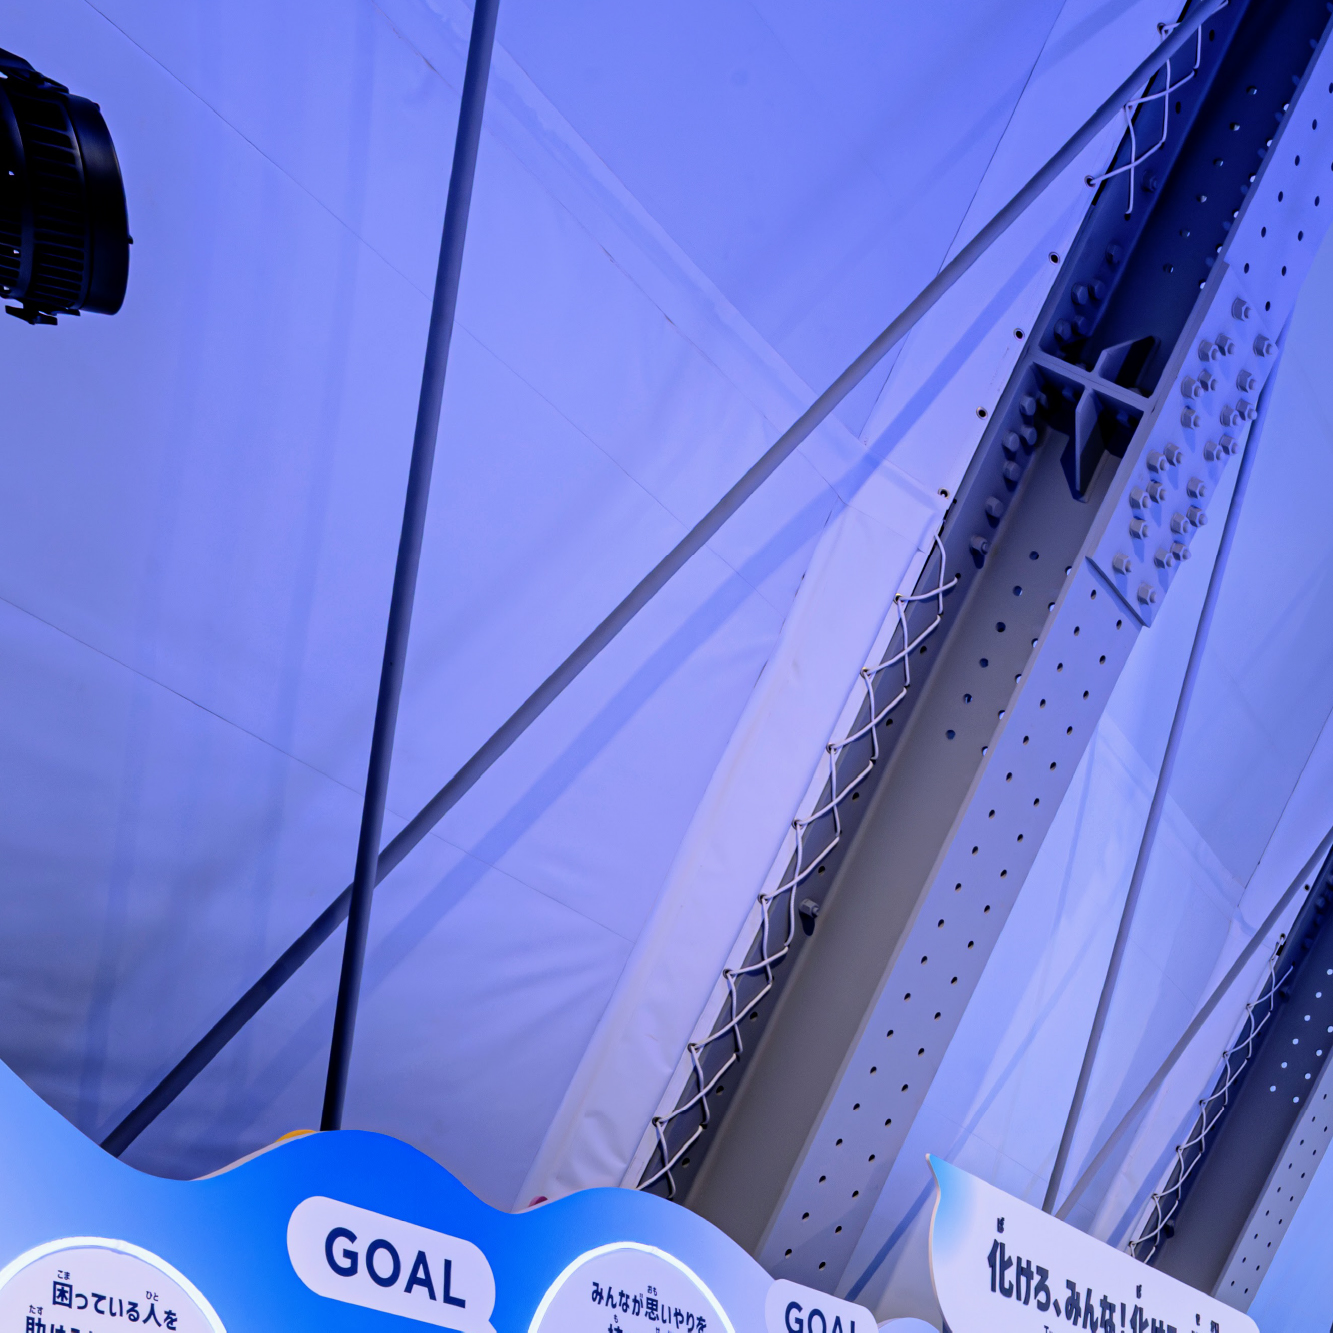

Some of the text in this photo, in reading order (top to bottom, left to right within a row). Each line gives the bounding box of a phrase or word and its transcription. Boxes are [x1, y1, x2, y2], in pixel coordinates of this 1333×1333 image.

[324, 1227, 466, 1308] GOAL
[52, 1281, 178, 1331] 困っている人を
